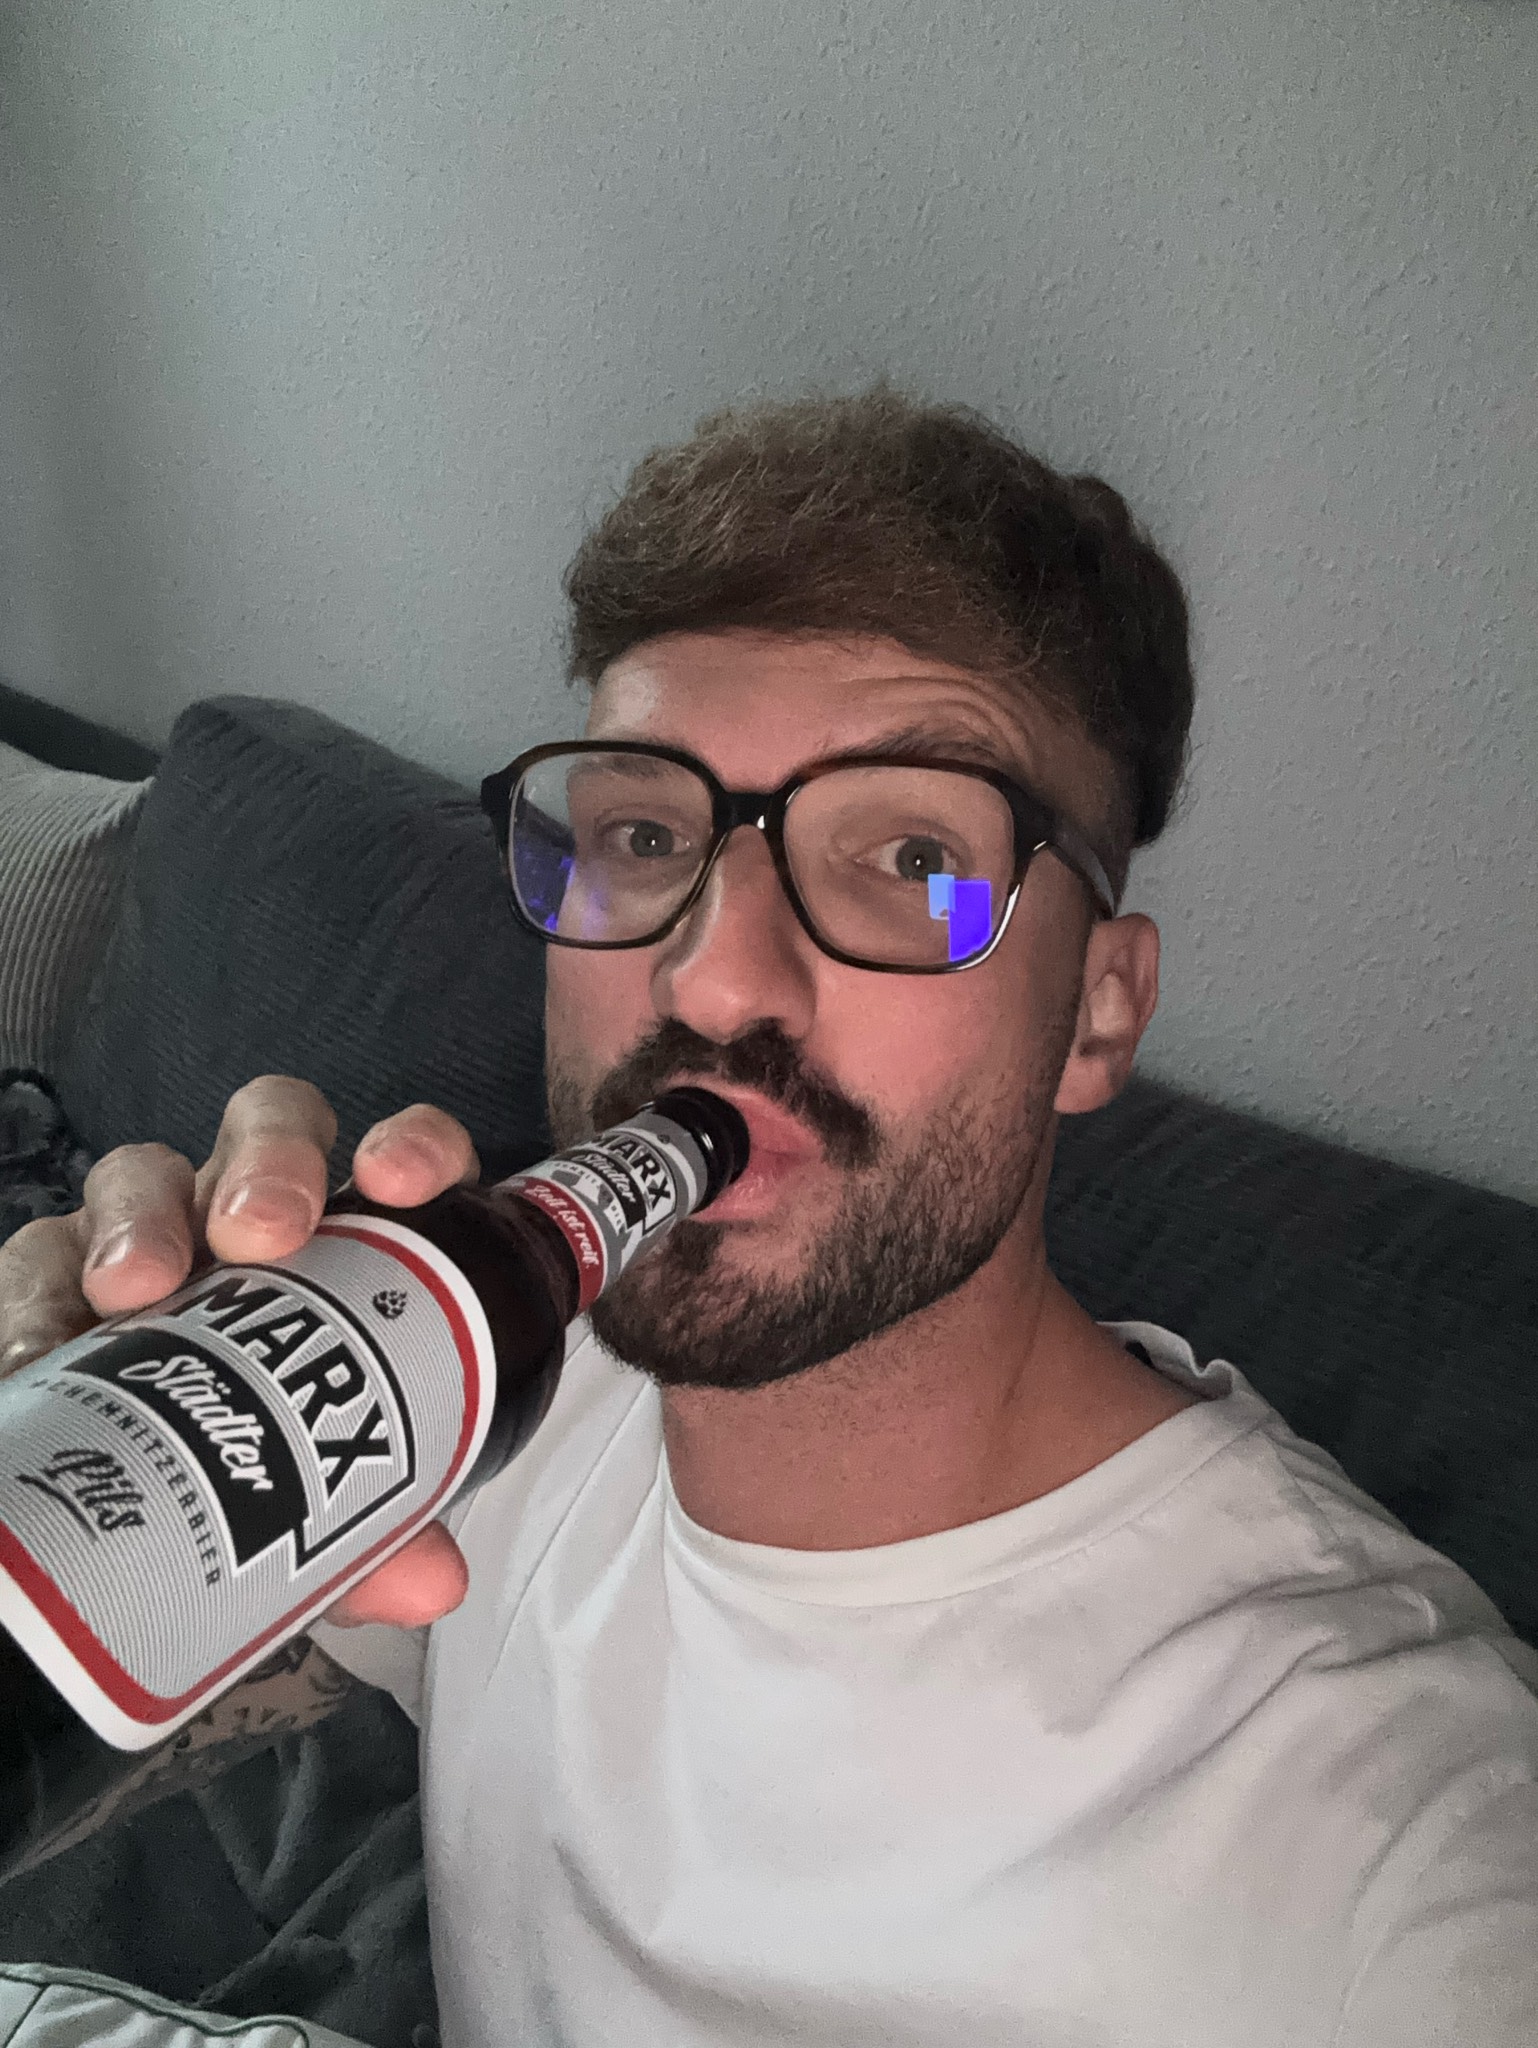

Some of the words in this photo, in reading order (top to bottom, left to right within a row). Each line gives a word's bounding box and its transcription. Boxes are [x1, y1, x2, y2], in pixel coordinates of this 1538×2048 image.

[118, 1354, 274, 1491] Städter
[166, 1276, 391, 1499] MARX
[42, 1449, 146, 1532] Pils
